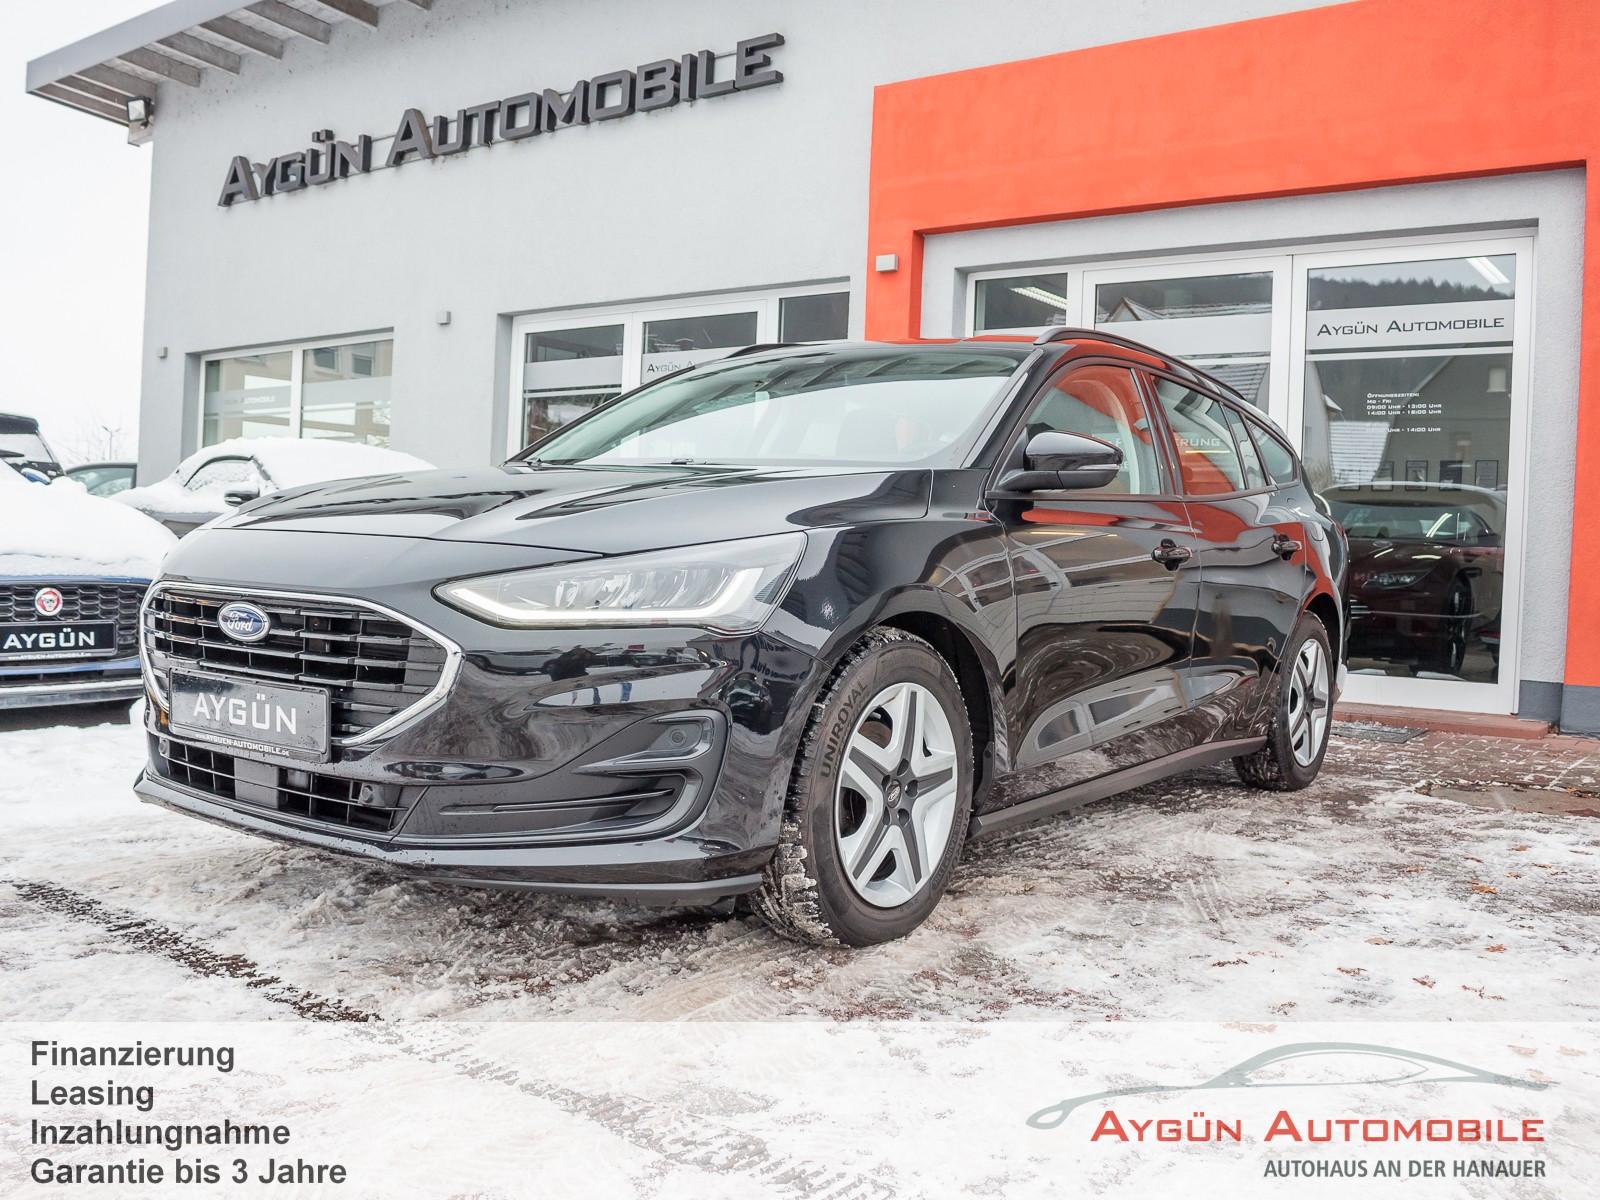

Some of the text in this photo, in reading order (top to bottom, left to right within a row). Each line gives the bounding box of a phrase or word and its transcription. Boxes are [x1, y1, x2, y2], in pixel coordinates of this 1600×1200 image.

[217, 32, 785, 207] AYGÜN AUTOMOBILE
[1317, 317, 1505, 336] AYGÜN AUTOMOBILE
[3, 628, 95, 650] AYGÜN
[193, 692, 297, 735] AYGÜN
[821, 681, 868, 778] UNIROYAL
